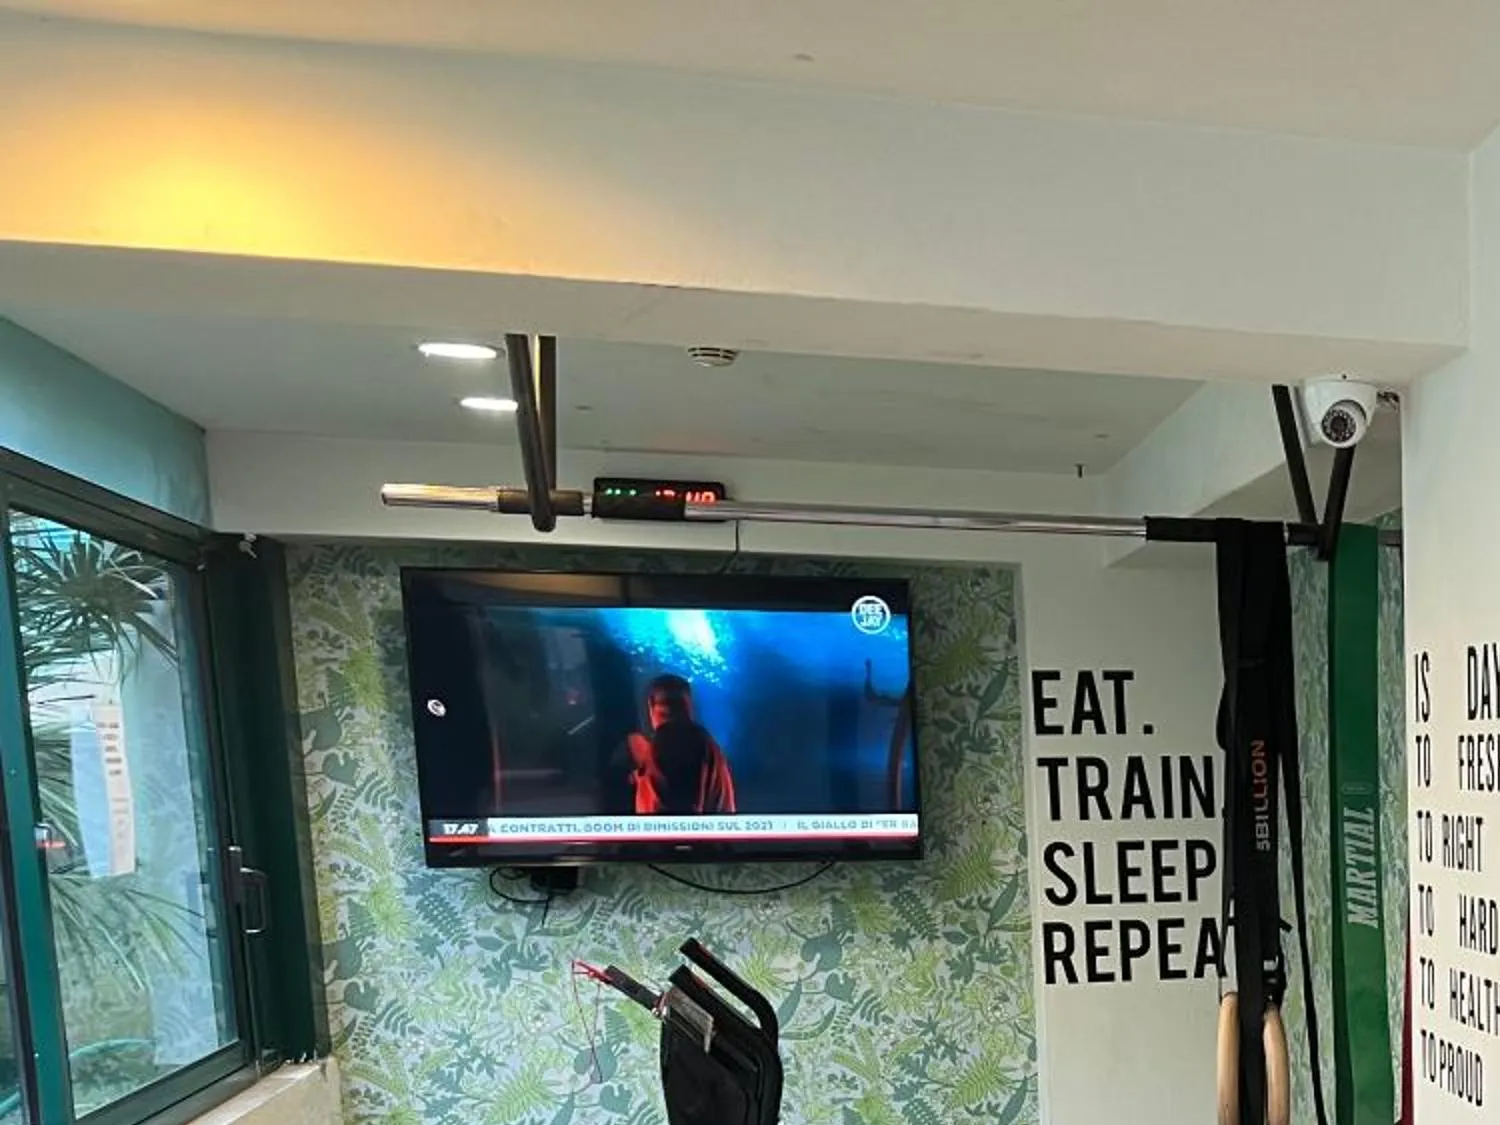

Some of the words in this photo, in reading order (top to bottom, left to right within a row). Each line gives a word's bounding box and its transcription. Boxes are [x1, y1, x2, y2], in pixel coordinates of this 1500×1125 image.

[1031, 670, 1155, 735] EAT.
[1415, 651, 1431, 722] IS
[1415, 734, 1431, 787] TO
[1043, 839, 1217, 906] SLEEP
[1344, 807, 1379, 929] MARTIAL
[1416, 810, 1433, 862] TO
[1442, 814, 1483, 872] RIGHT
[1042, 917, 1235, 984] REPEA
[1418, 884, 1434, 937] TO
[1459, 893, 1498, 955] HARD
[1419, 956, 1435, 1010] TO
[1421, 1028, 1437, 1083] TO
[1439, 1039, 1483, 1107] PROUD
